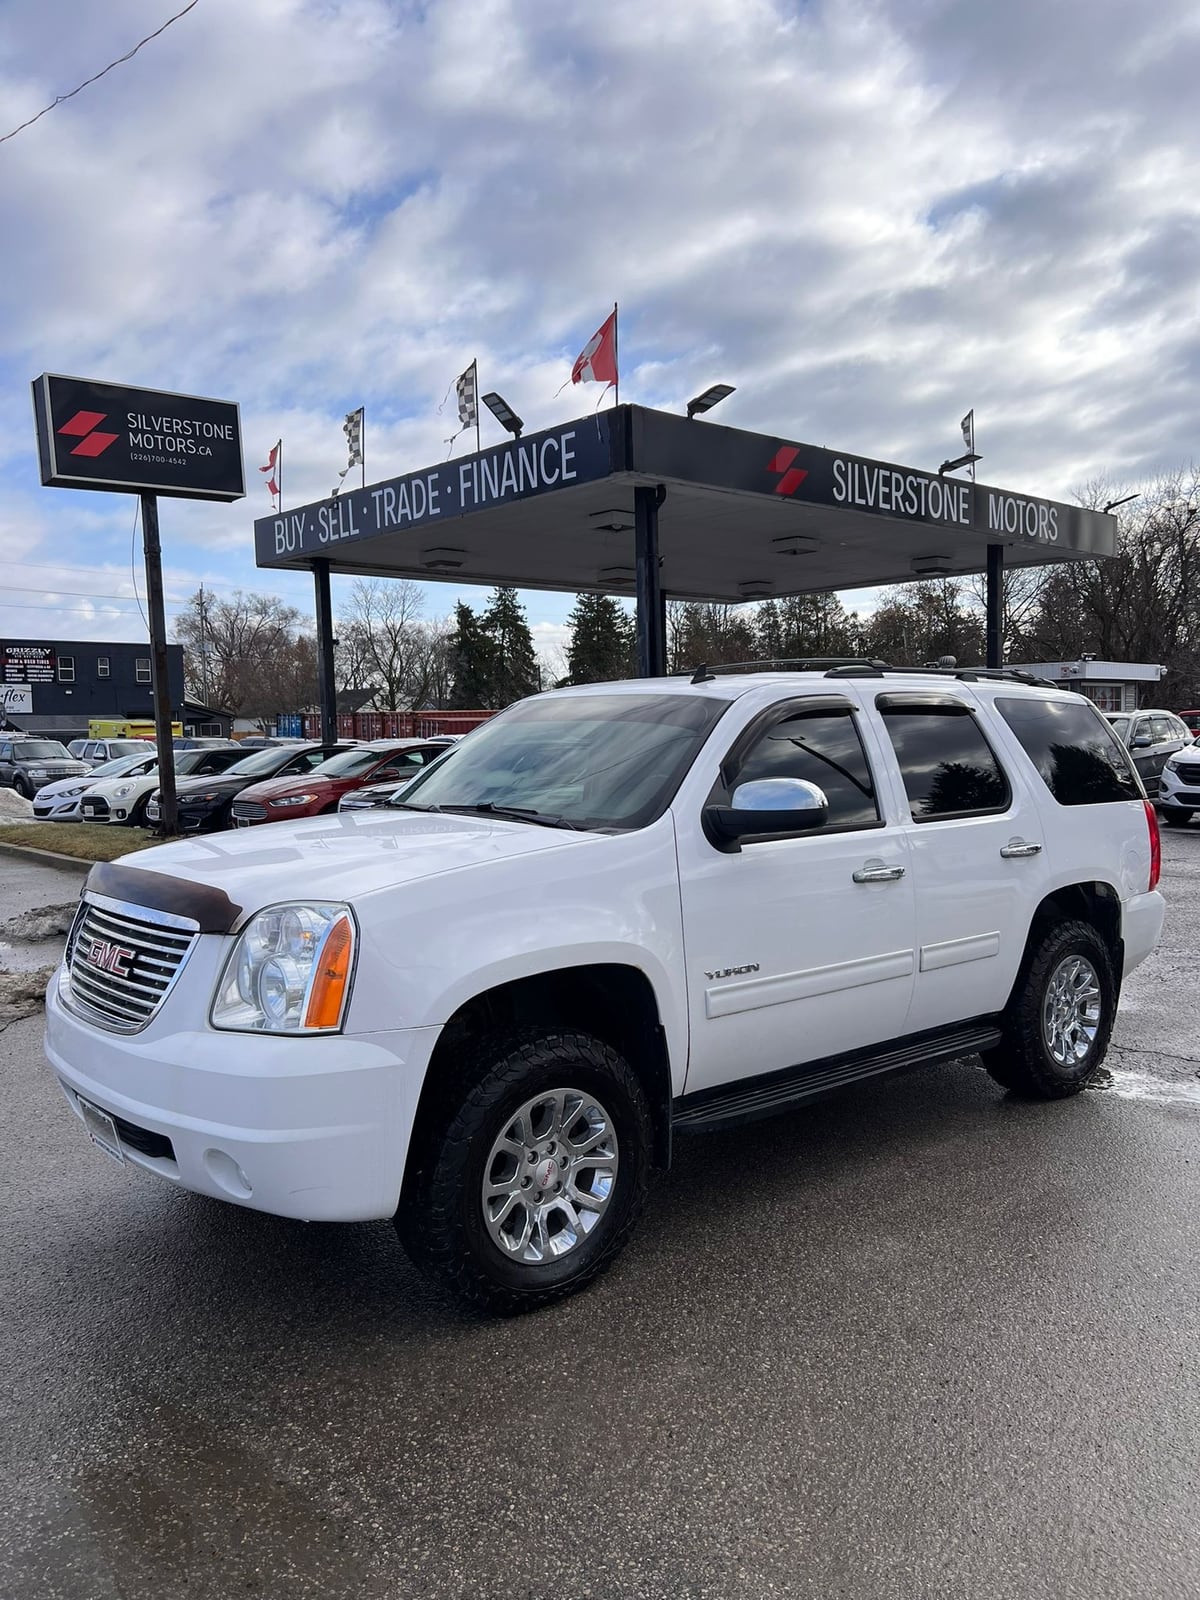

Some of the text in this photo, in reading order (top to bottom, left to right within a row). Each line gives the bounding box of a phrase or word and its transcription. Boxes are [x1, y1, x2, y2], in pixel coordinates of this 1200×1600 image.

[127, 412, 234, 441] SILVERSTONE
[130, 452, 188, 466] (226)700-4542
[274, 431, 577, 554] BUY SELL TRADE FINANCE
[832, 459, 1058, 541] SILVERSTONE MOTORS
[6, 647, 51, 655] GRIZZLY
[87, 938, 136, 978] GMC
[704, 963, 760, 980] YUKON
[541, 1161, 554, 1186] GMC
